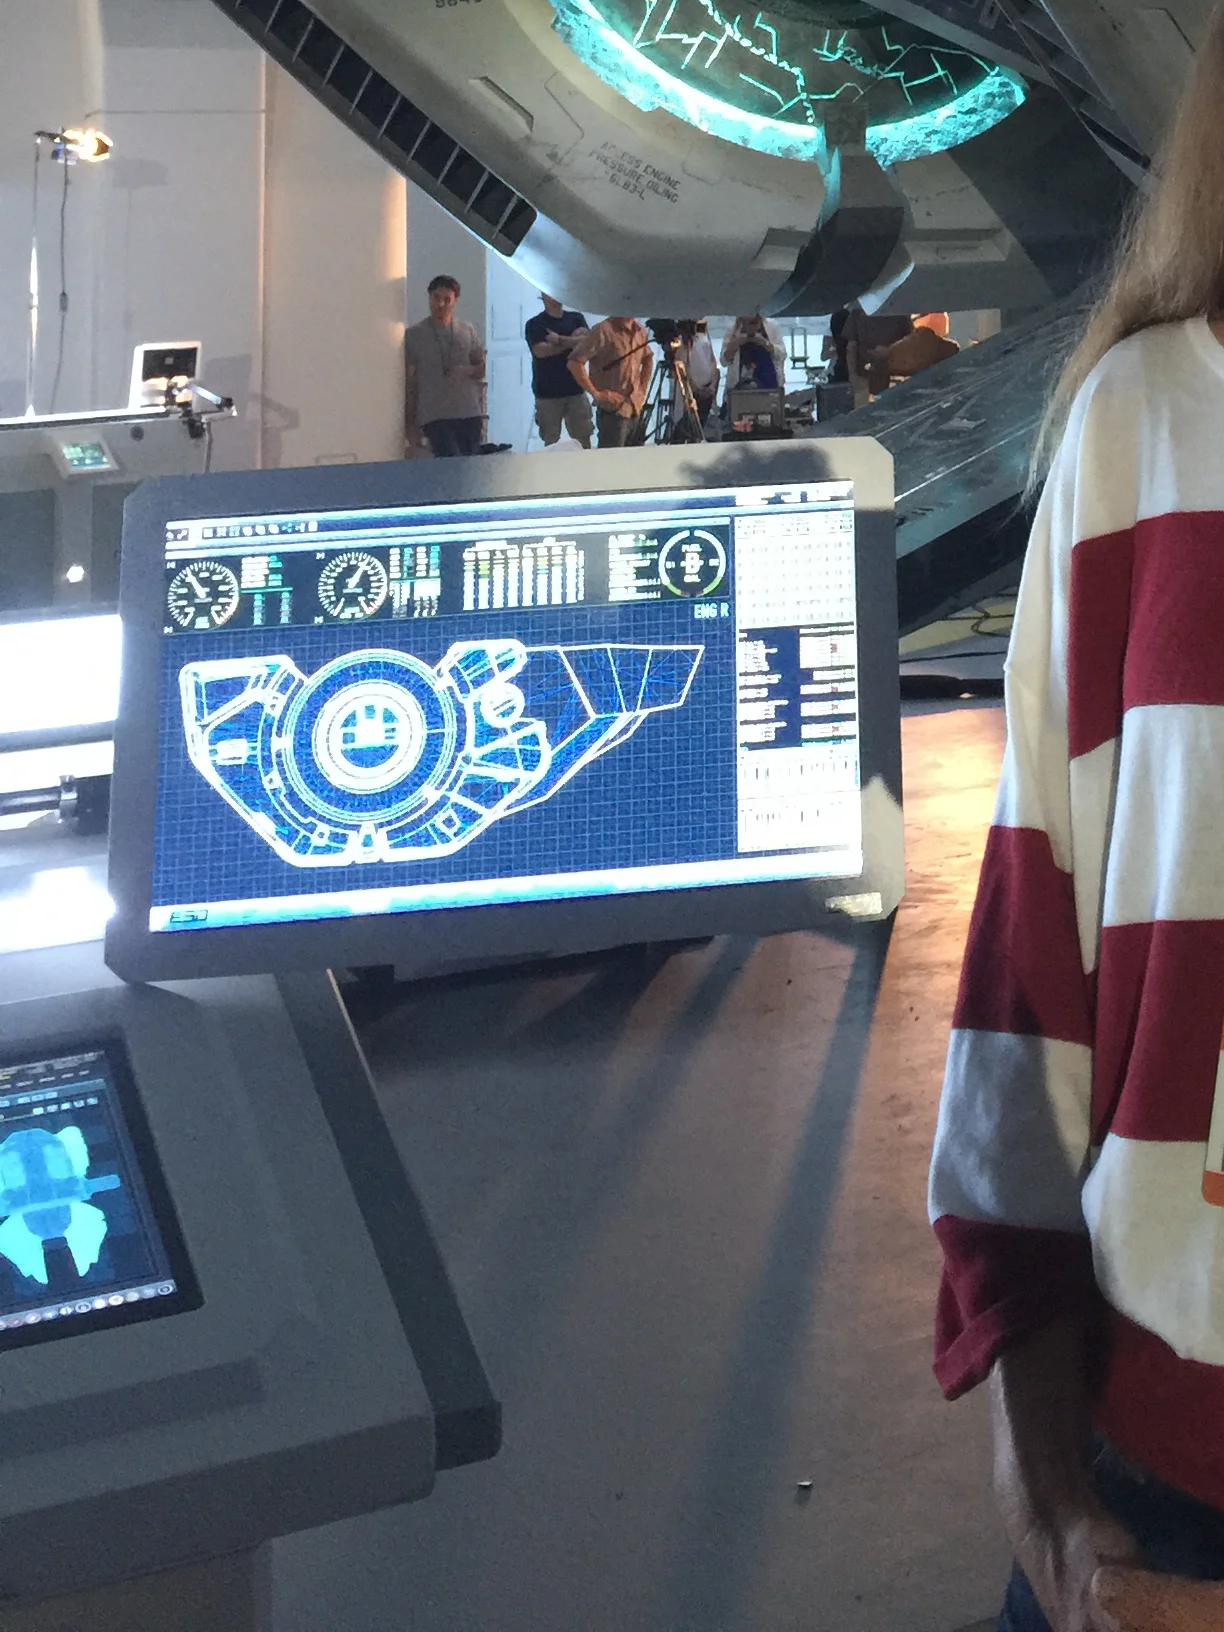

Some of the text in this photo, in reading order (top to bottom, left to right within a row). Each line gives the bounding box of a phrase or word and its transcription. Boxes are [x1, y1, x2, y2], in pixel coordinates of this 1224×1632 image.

[642, 164, 682, 191] ENGINE
[694, 602, 730, 619] ENG R
